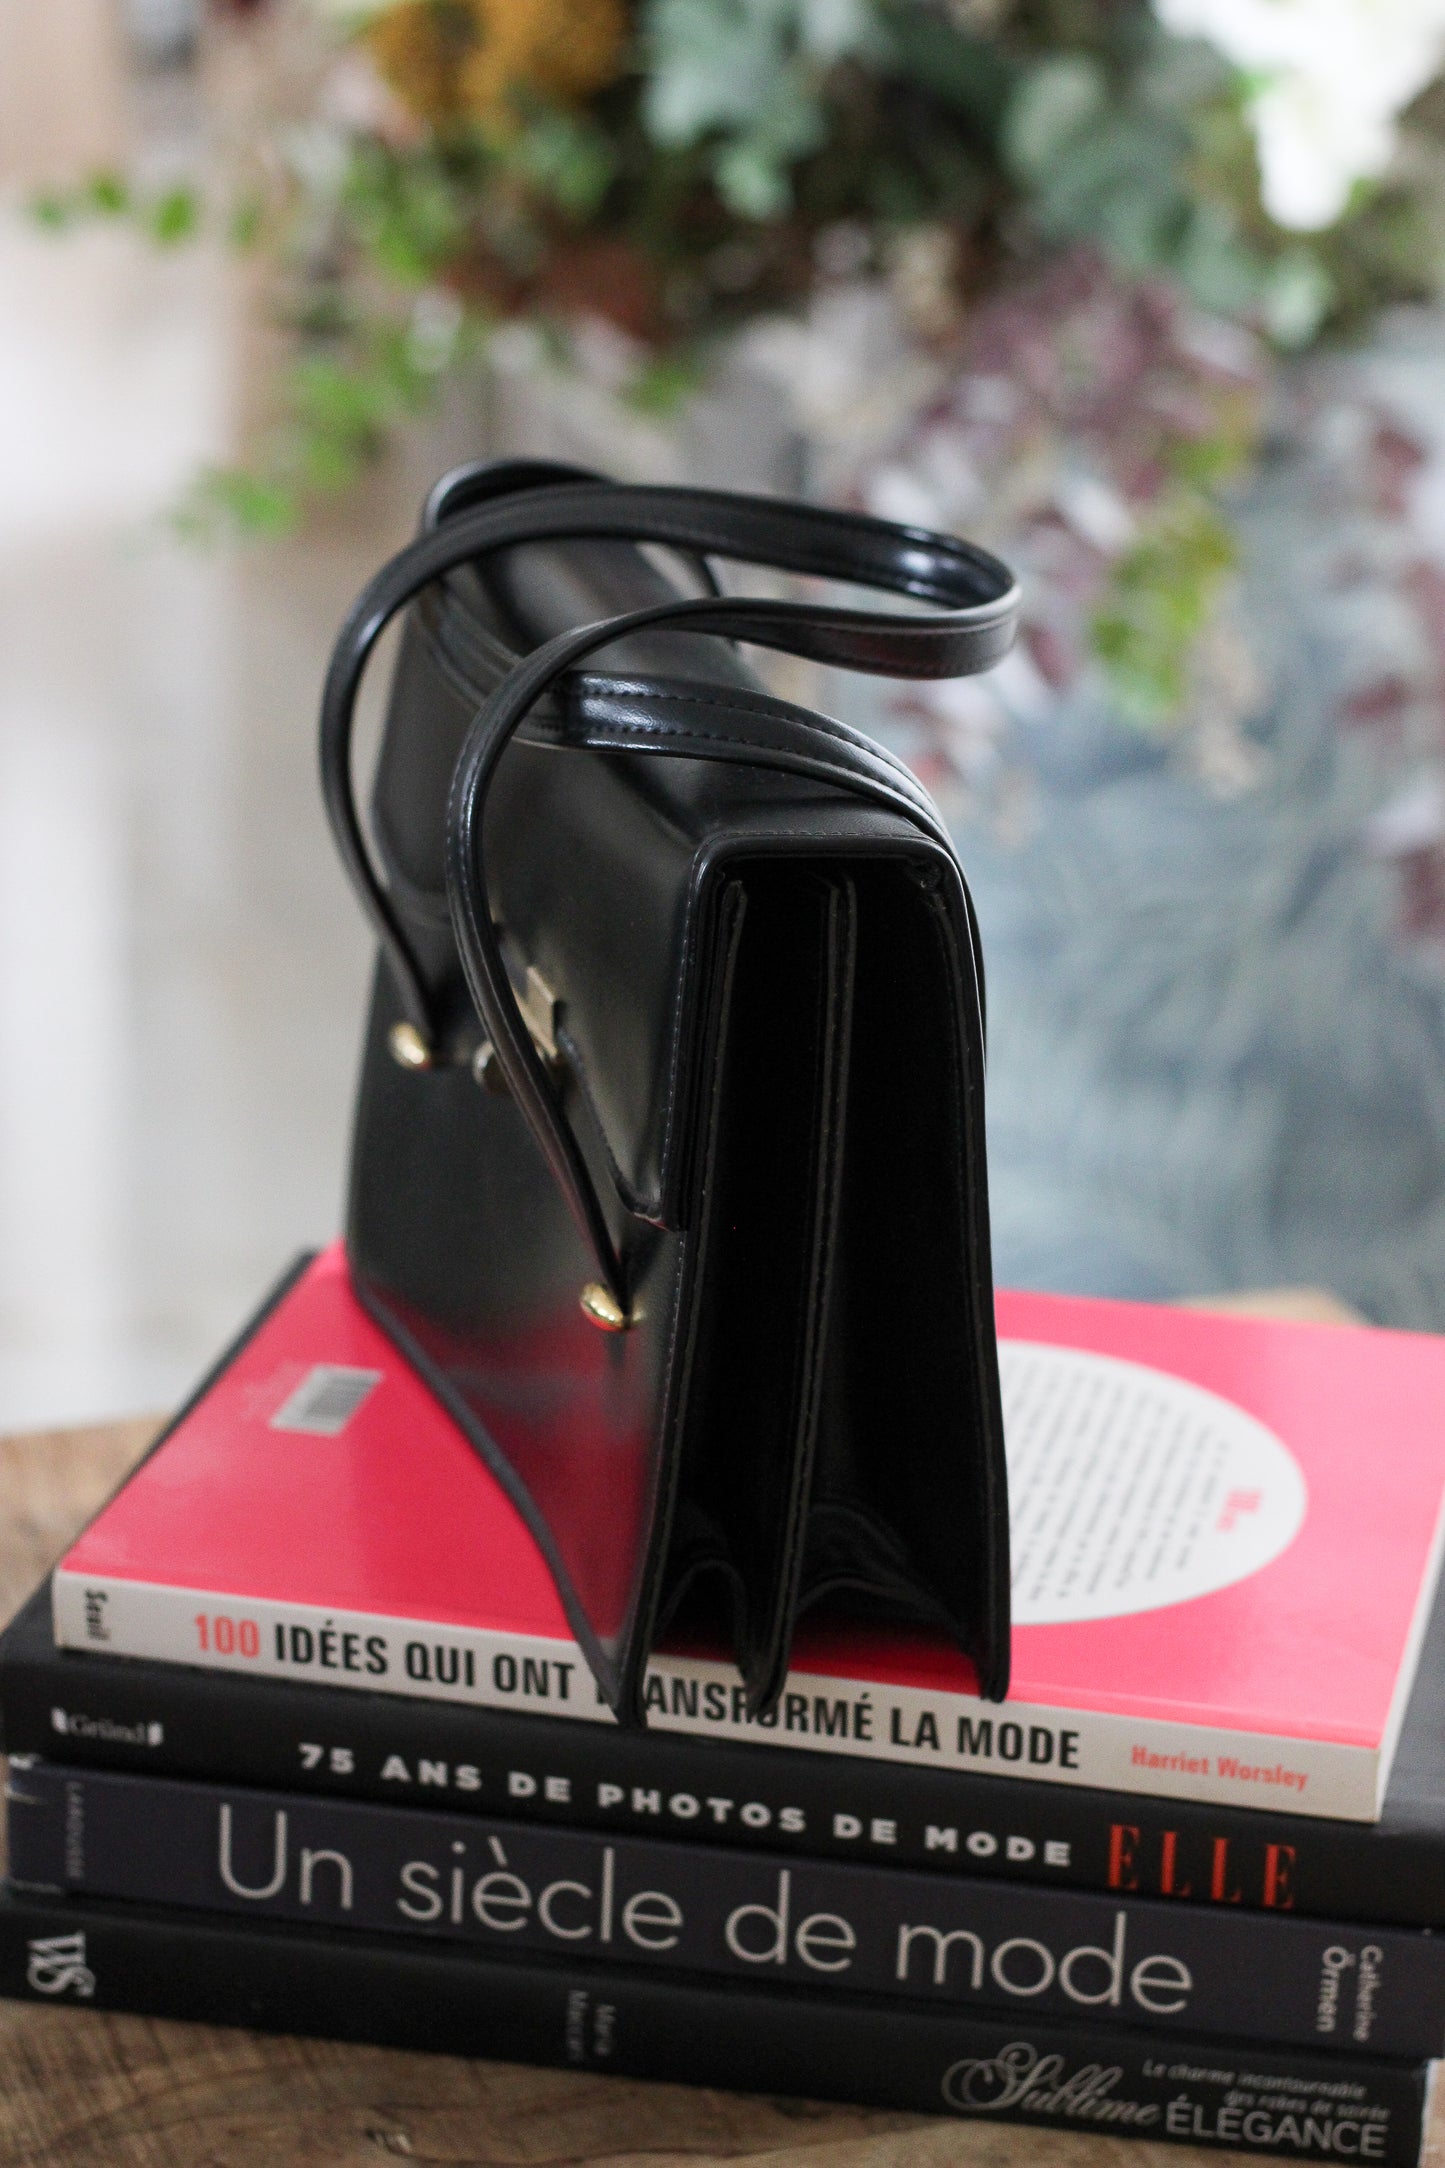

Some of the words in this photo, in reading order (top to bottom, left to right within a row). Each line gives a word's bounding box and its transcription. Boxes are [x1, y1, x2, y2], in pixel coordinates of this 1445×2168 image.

[194, 1614, 260, 1659] 100
[274, 1620, 389, 1676] IDÉES
[406, 1641, 476, 1688] QUI
[492, 1654, 575, 1702] ONT
[594, 1672, 872, 1742] ANSFRMÉ
[890, 1707, 941, 1751] LA
[957, 1716, 1080, 1770] MODE
[300, 1744, 354, 1773] 75
[381, 1756, 482, 1791] ANS
[508, 1771, 572, 1802] DE
[598, 1783, 807, 1833] PHOTOS
[833, 1814, 897, 1845] DE
[925, 1825, 1072, 1867] MODE
[1131, 1745, 1209, 1775] Harriet
[1218, 1758, 1308, 1793] Worsley
[219, 1804, 354, 1911] Un
[398, 1836, 684, 1951] siècle
[725, 1869, 857, 1972] de
[896, 1911, 1193, 2014] mode
[1107, 1824, 1297, 1910] ELLE
[1353, 1944, 1383, 2043] Catherine
[941, 2041, 1161, 2127] Sublime
